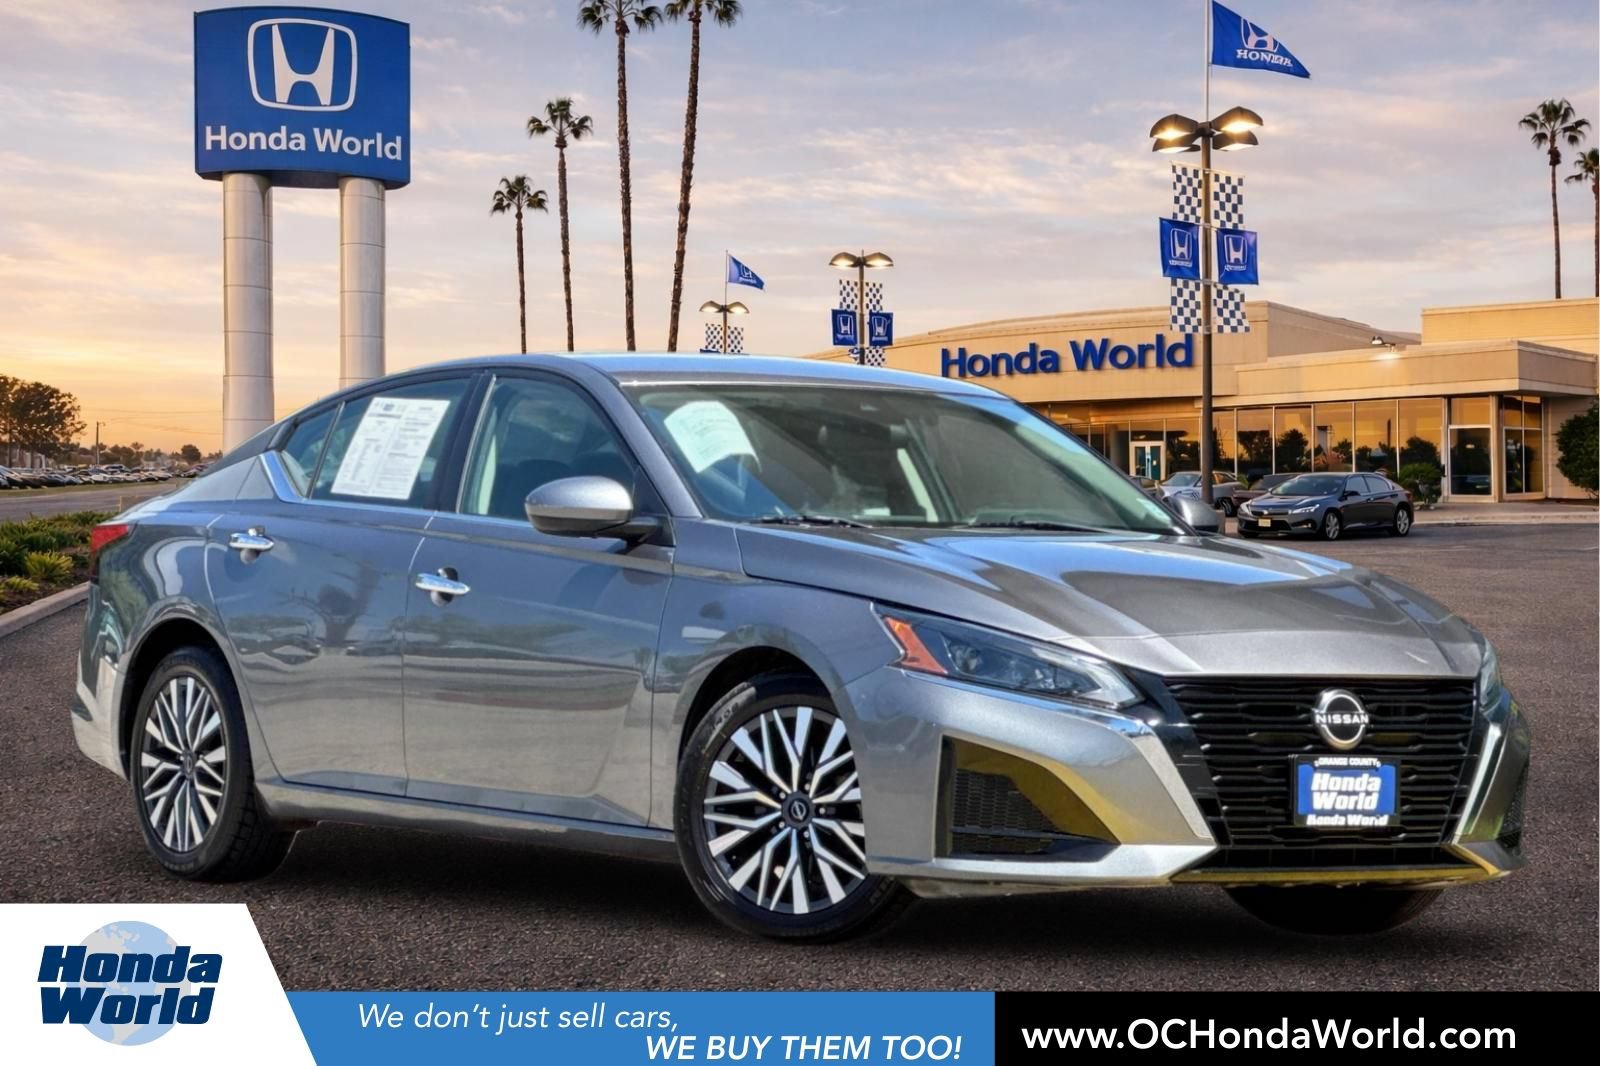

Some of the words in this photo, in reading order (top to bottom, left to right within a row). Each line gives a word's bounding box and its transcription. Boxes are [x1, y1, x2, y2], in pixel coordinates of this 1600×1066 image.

[205, 125, 306, 151] Honda
[313, 127, 402, 161] World
[941, 342, 1061, 378] Honda
[1069, 333, 1195, 371] World
[1315, 714, 1369, 724] NISSAN
[1349, 757, 1378, 767] COUNTY
[1311, 772, 1382, 791] Honda
[1312, 791, 1379, 810] World
[1306, 814, 1346, 826] Honda
[1347, 814, 1389, 826] World
